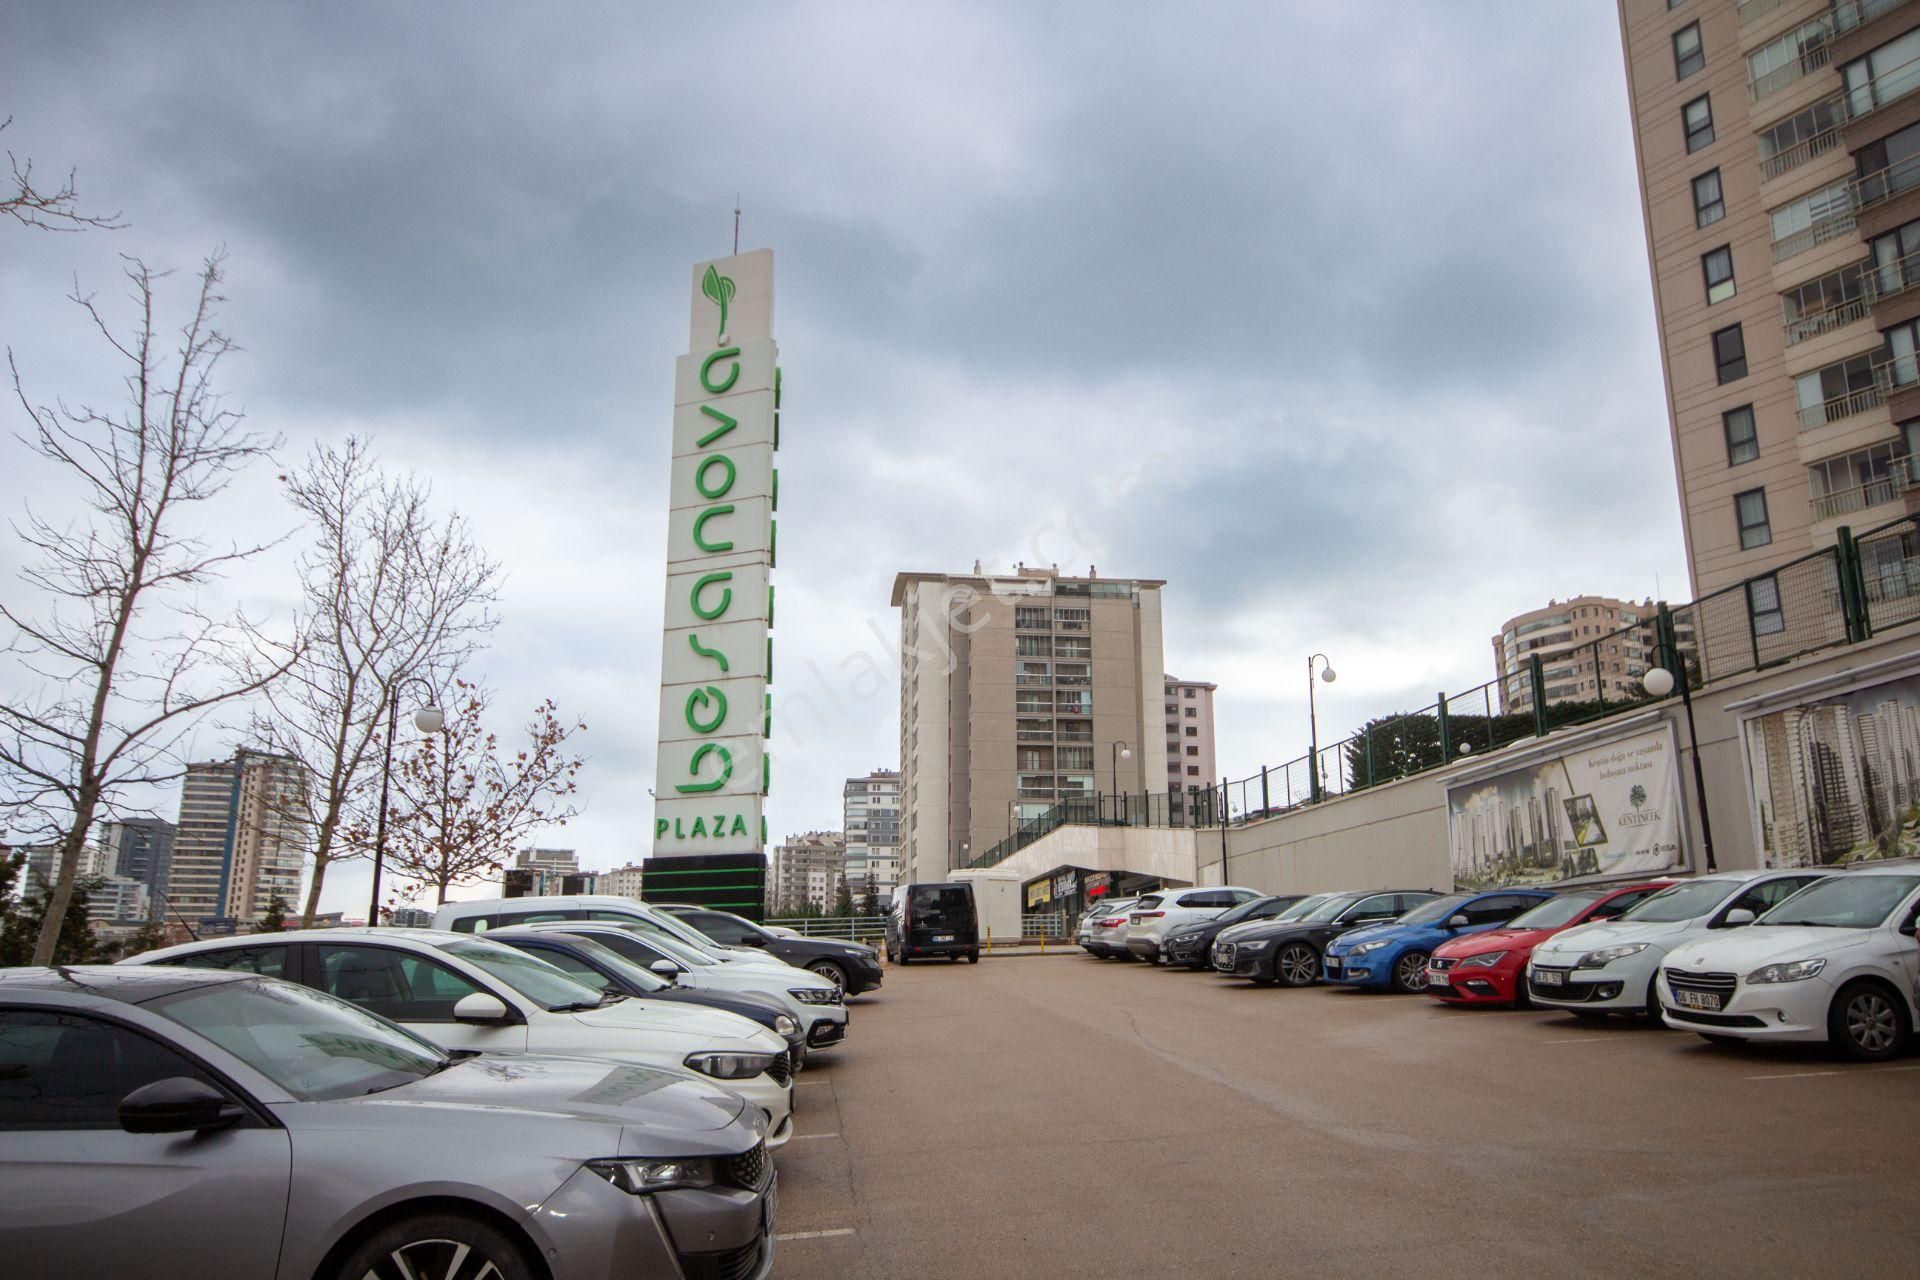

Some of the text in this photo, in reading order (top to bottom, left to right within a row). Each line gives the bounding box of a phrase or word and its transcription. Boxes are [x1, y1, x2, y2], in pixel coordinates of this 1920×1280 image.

[674, 346, 741, 794] besanova
[1588, 755, 1610, 769] Kentin
[1610, 752, 1626, 764] doğa
[656, 814, 748, 841] PLAZA
